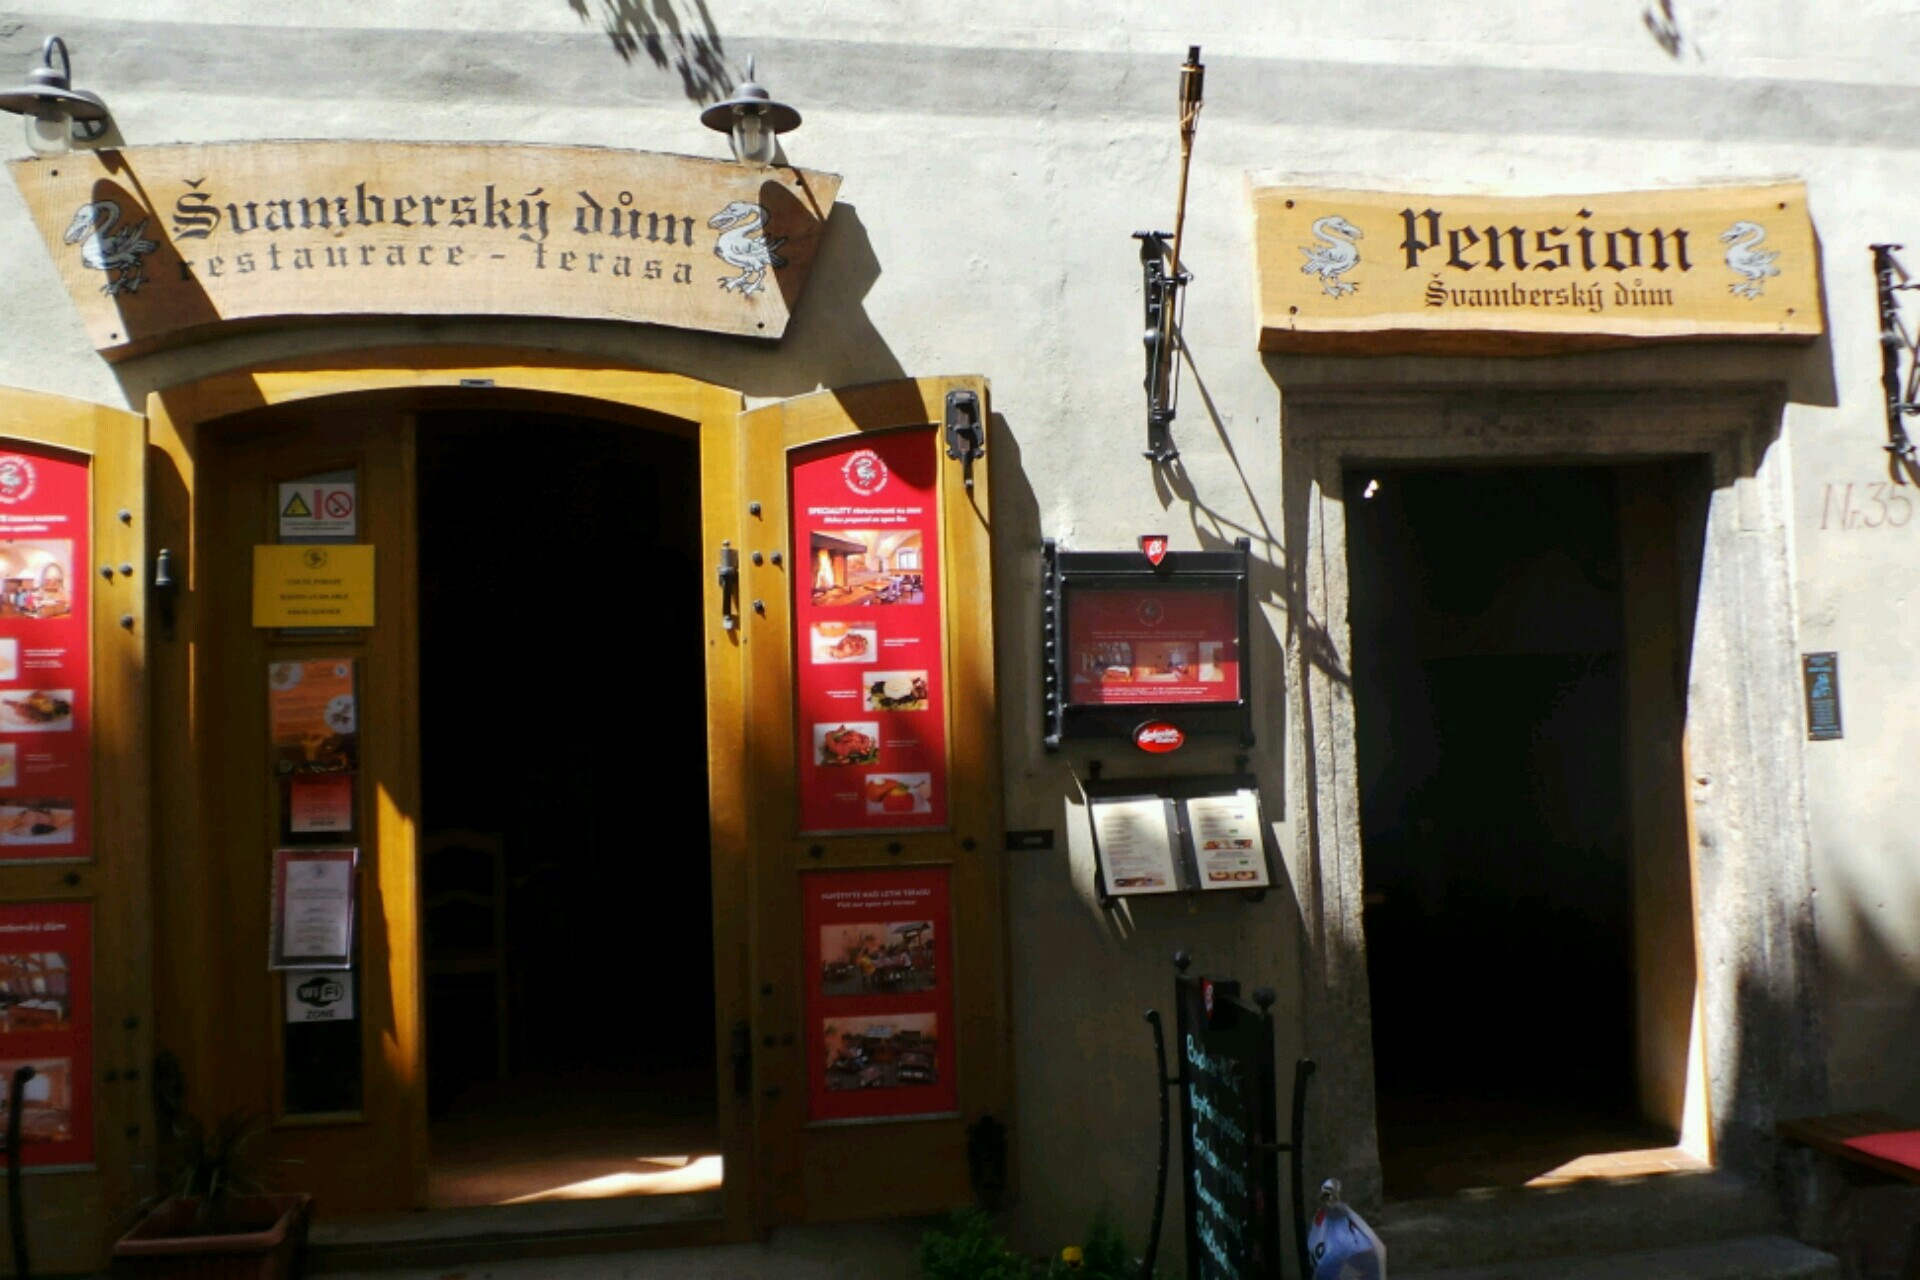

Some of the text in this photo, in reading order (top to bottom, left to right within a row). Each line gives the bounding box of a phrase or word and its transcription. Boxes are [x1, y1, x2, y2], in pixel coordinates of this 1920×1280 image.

[173, 177, 695, 247] Švamberský dům
[1398, 207, 1693, 272] Pension
[178, 242, 464, 281] restaurace
[534, 242, 692, 285] terasa
[1425, 272, 1675, 313] Švamberský dům
[306, 1009, 335, 1020] ZONE
